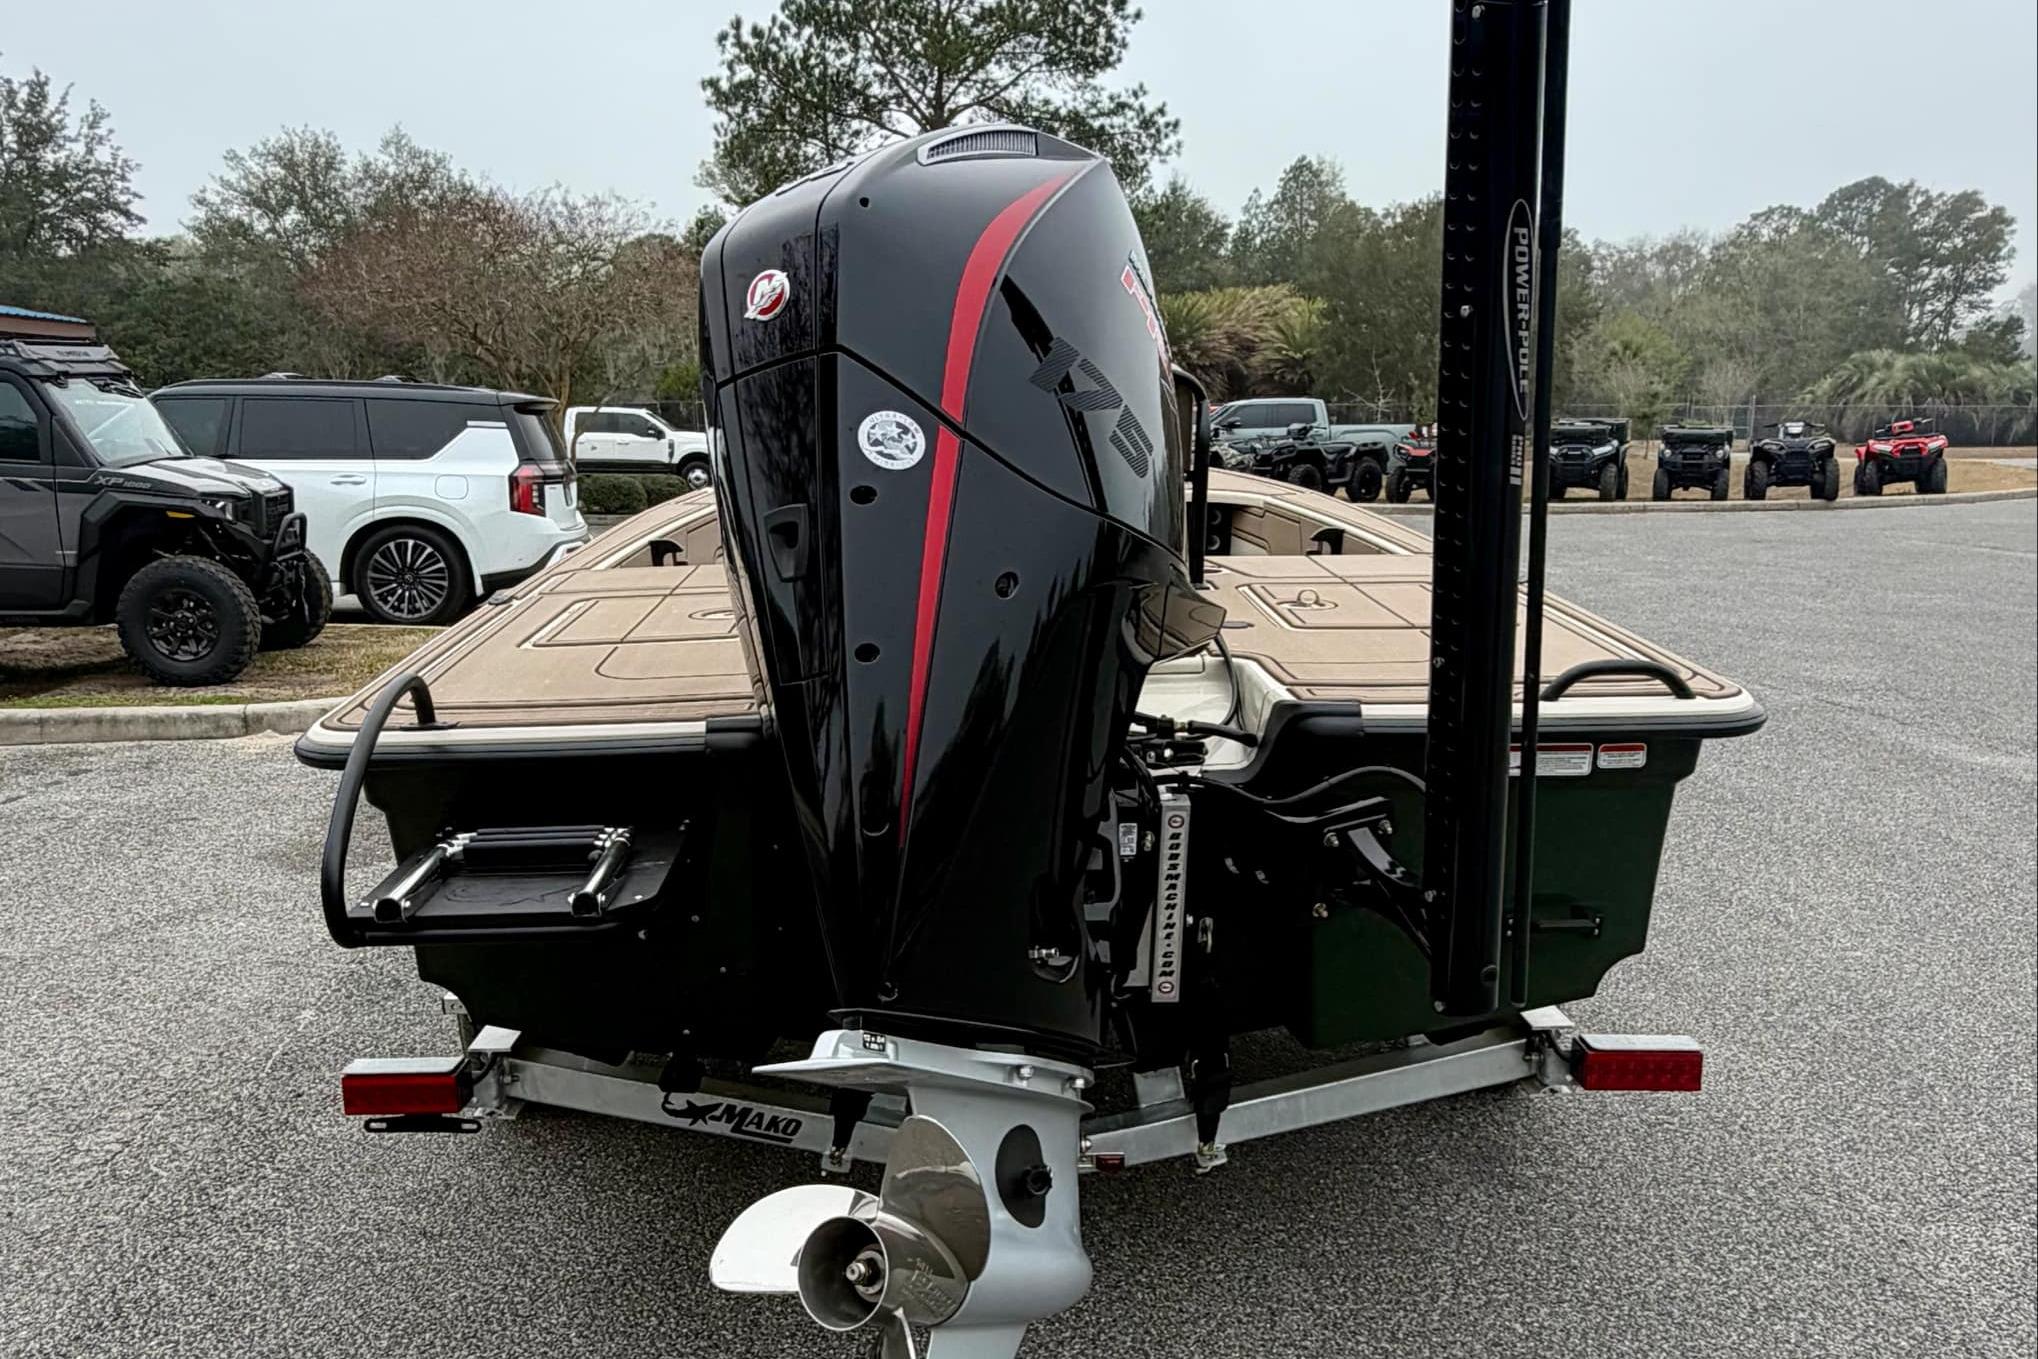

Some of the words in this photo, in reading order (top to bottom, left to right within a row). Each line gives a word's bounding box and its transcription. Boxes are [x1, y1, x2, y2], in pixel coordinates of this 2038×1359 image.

[1513, 227, 1531, 394] POWER-POLE
[1029, 336, 1154, 479] 175
[94, 476, 124, 486] XP
[123, 480, 152, 489] 1000
[1158, 832, 1182, 978] BOBSMACHINE.COM
[708, 1103, 802, 1144] MAKO
